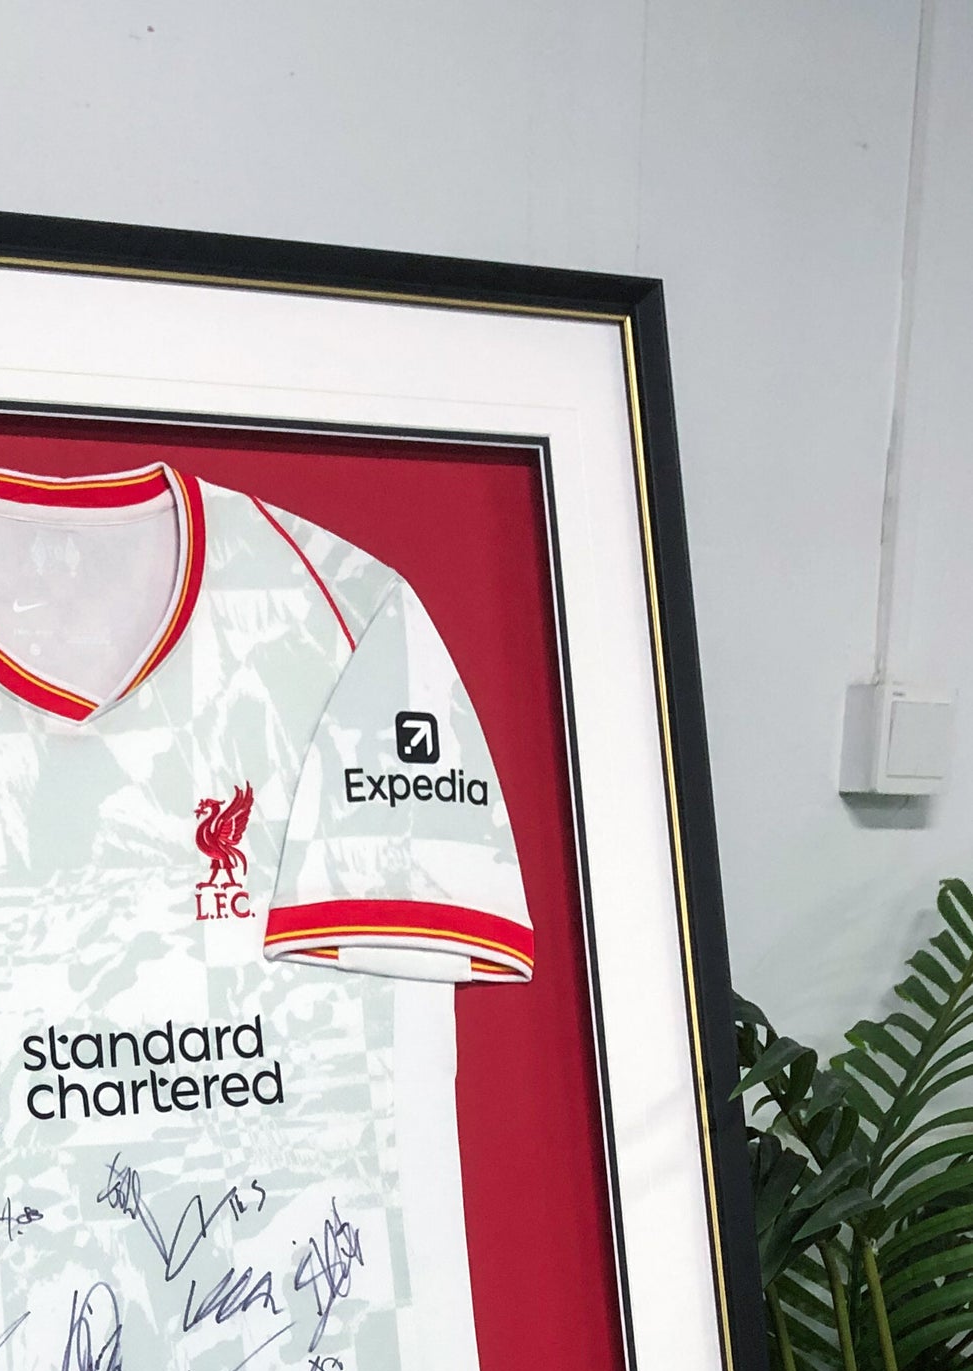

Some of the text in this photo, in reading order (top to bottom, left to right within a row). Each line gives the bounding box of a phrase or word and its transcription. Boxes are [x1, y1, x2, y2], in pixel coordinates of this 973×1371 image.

[345, 767, 488, 807] Expedia
[195, 891, 256, 921] L.F.C.
[23, 1014, 264, 1072] standard
[26, 1060, 284, 1120] chartered
